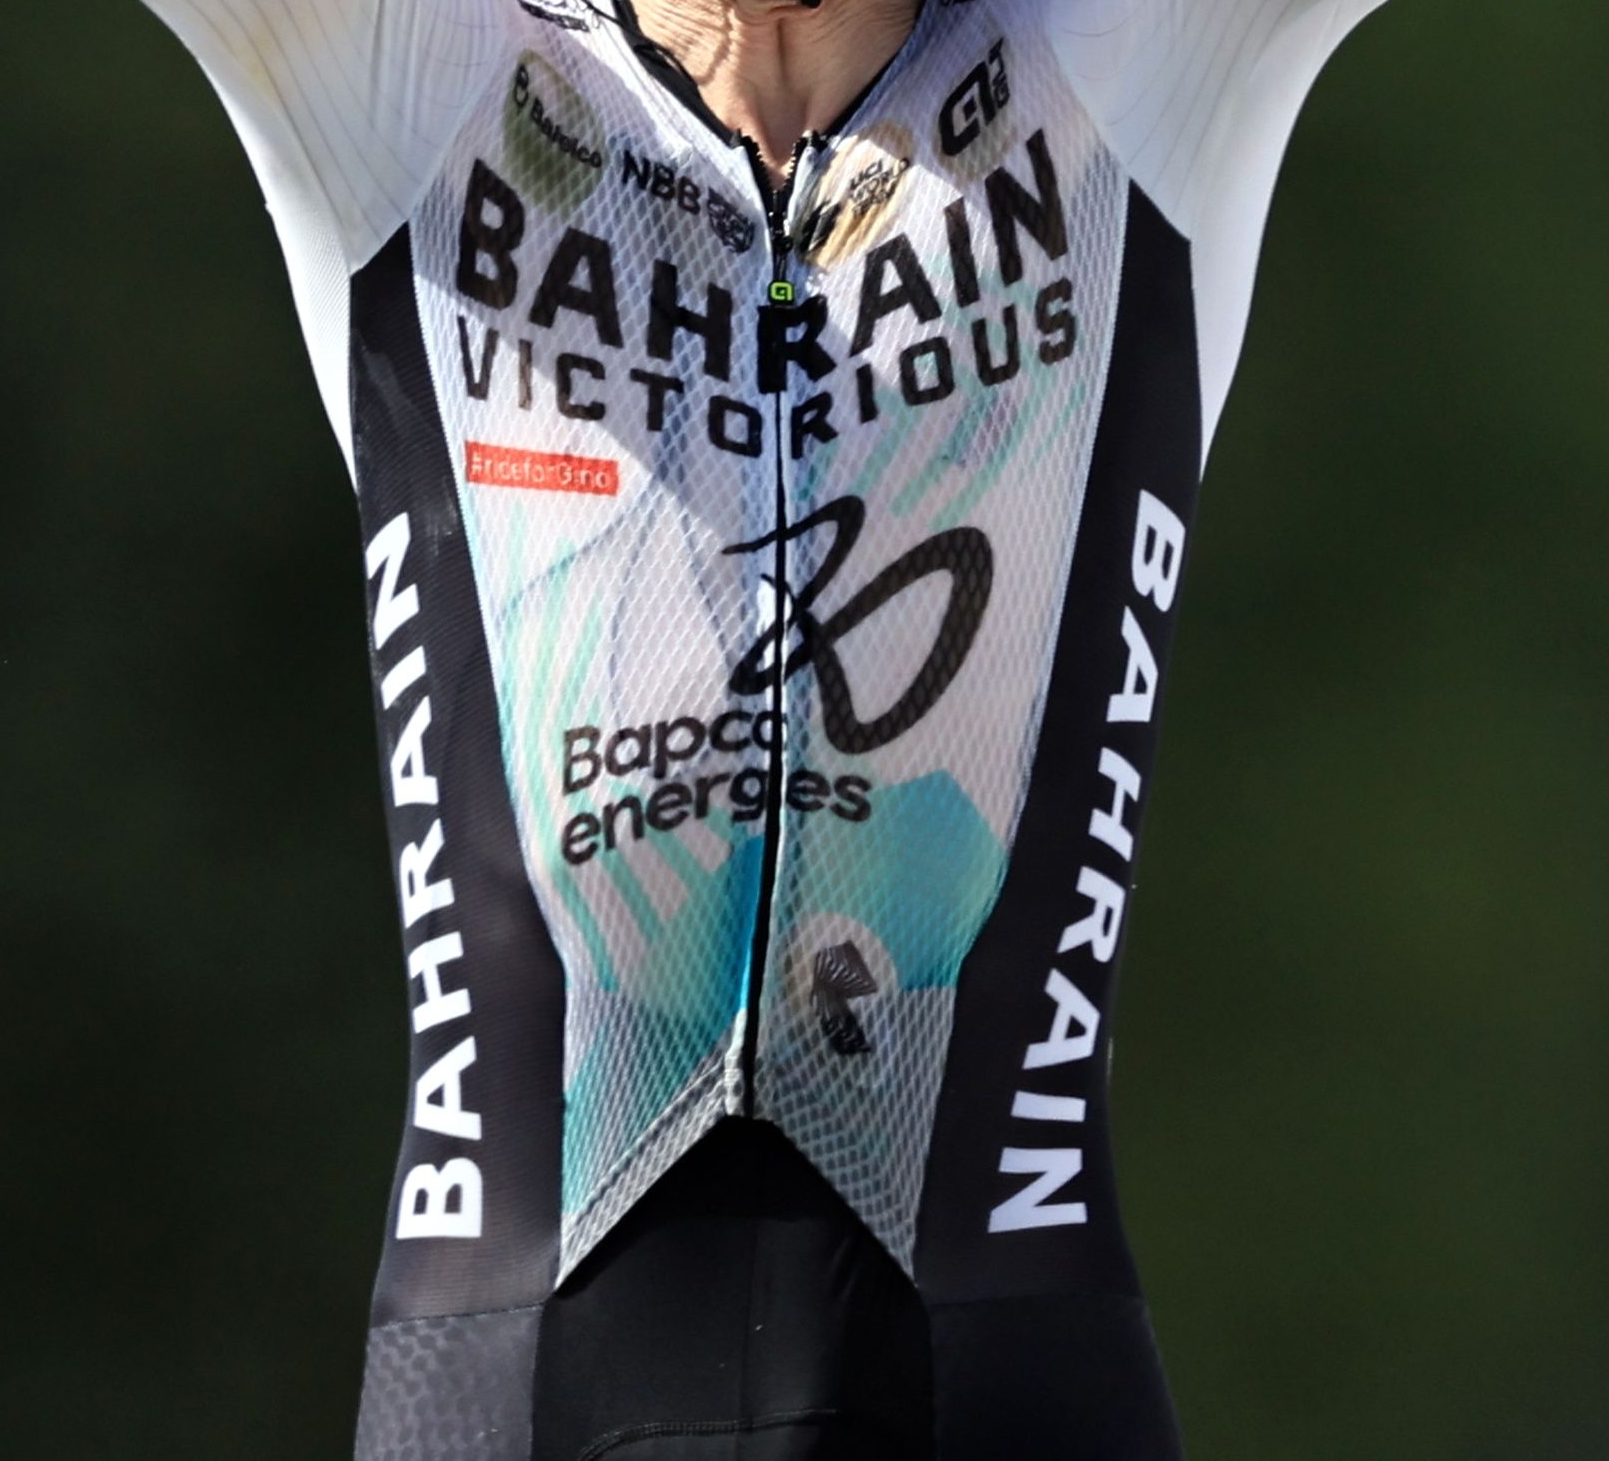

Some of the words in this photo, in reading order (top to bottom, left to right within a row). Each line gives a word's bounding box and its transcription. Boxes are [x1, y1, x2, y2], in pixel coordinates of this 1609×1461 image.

[455, 129, 1069, 394] BAHRAIN
[622, 149, 701, 216] NBB
[456, 276, 1077, 460] VICTORIOUS
[560, 766, 873, 867] energes
[562, 709, 788, 796] Bapco
[363, 510, 483, 1242] BAHRAIN
[986, 488, 1188, 1235] BAHRAIN
